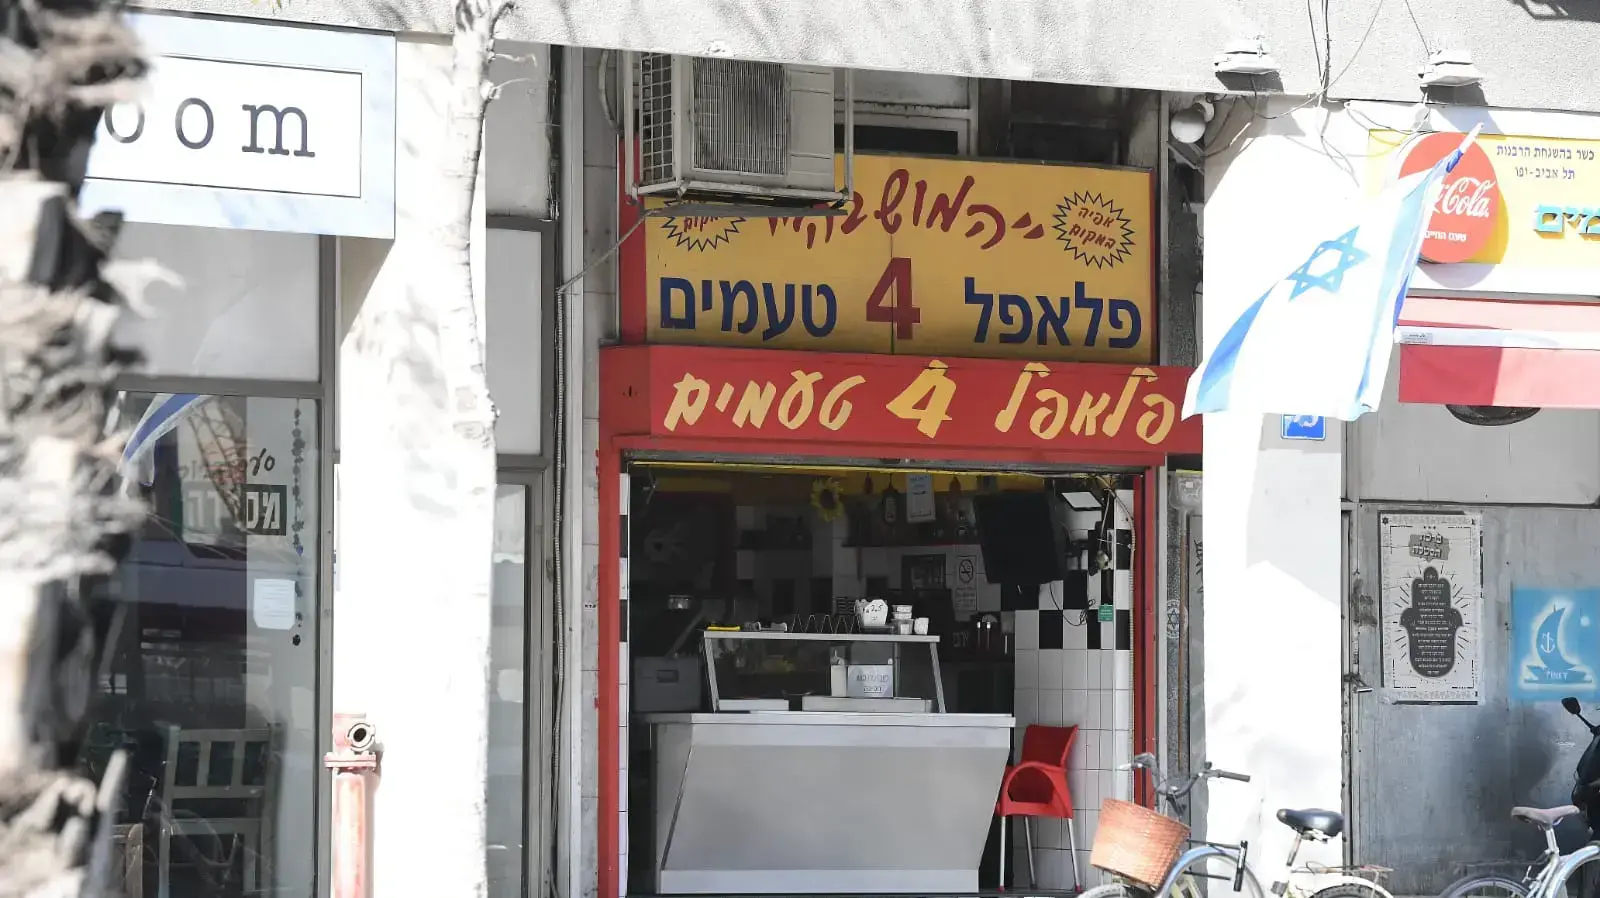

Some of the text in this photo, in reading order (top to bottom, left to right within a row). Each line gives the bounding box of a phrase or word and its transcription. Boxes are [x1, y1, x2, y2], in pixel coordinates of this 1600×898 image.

[1496, 144, 1595, 161] כשר בהשגחת הרבנות
[1562, 167, 1575, 180] תל
[1078, 207, 1115, 228] אפיה
[1068, 224, 1117, 250] במקום
[660, 257, 1142, 349] פלאפל 4 טעמים
[663, 359, 1176, 446] פלאפל 4 טעמים
